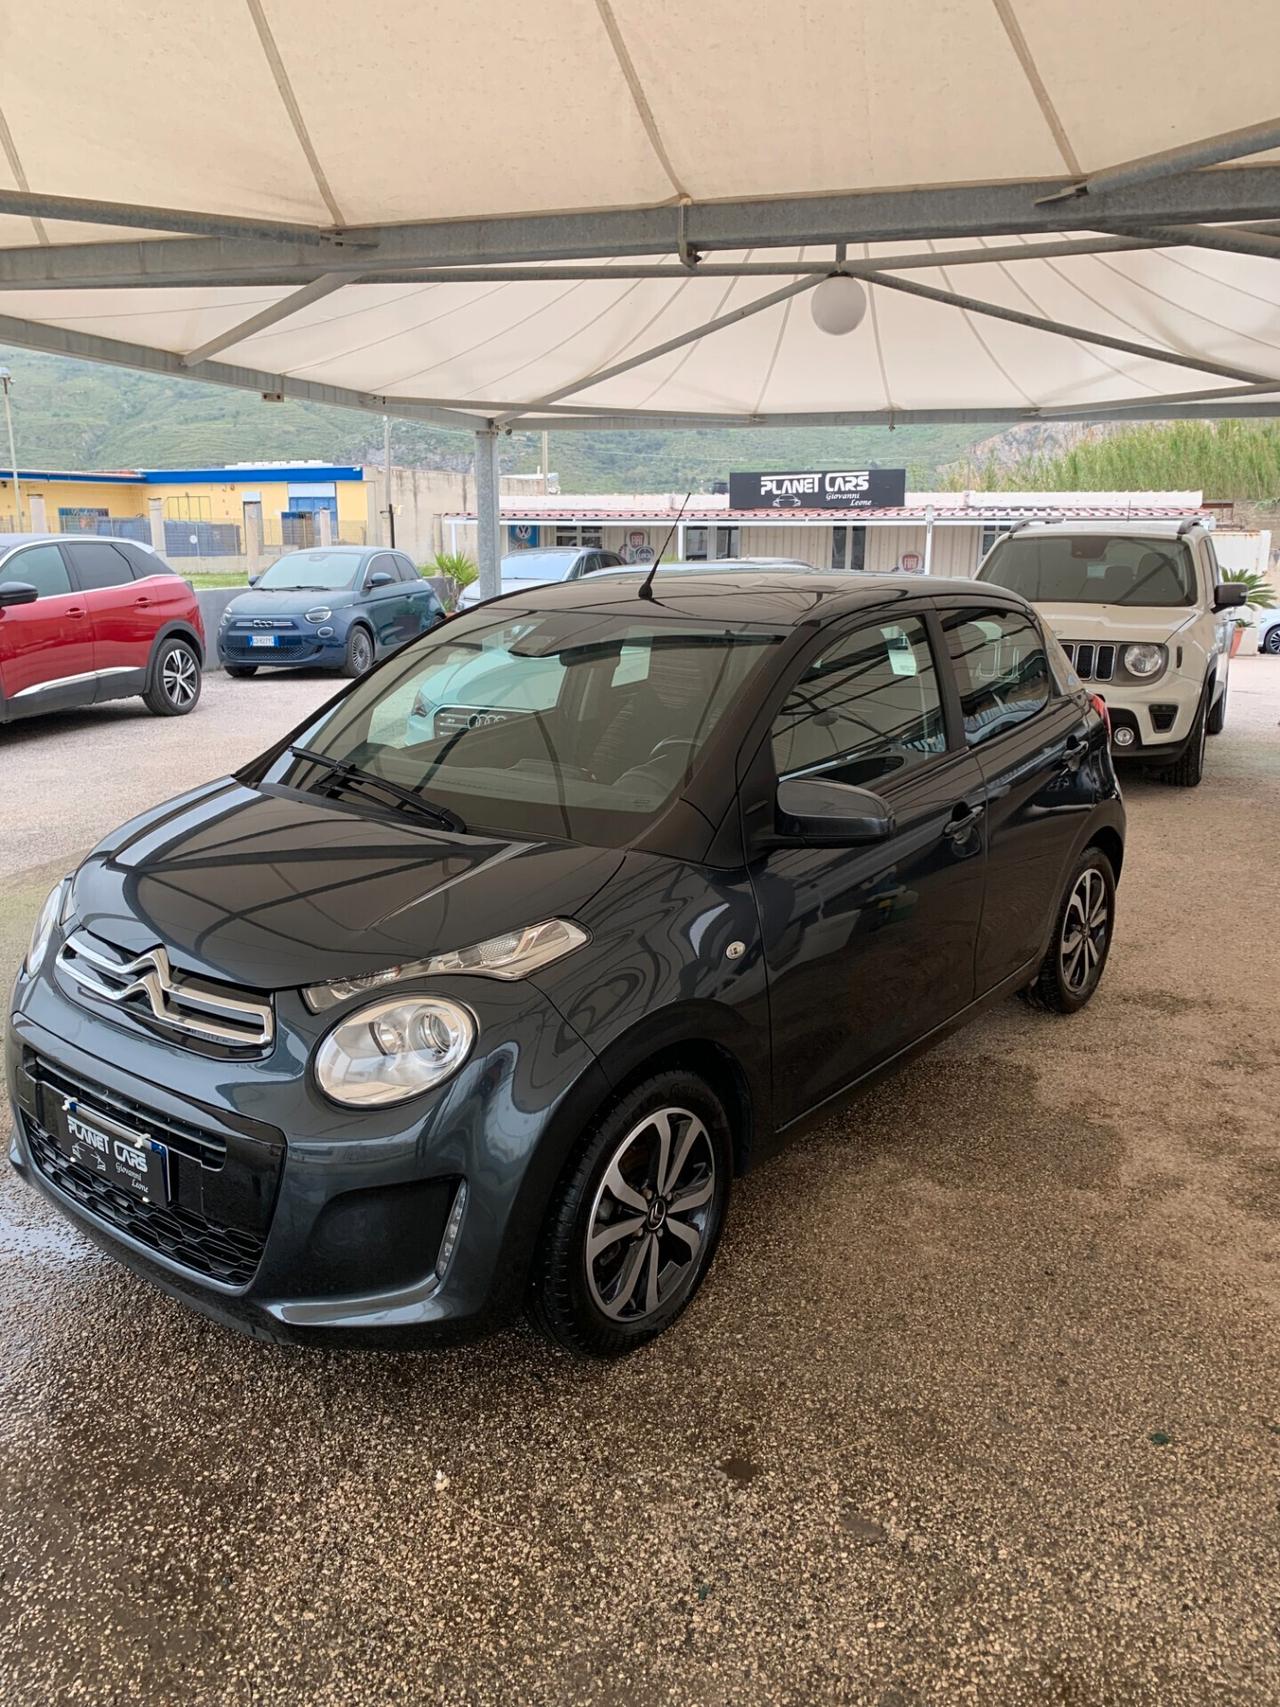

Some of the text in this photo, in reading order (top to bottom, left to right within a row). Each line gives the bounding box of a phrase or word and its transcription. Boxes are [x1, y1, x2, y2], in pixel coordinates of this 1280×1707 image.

[761, 471, 869, 495] PLANET CARS
[825, 492, 860, 501] Giovanni
[850, 498, 872, 507] Leone
[67, 1114, 149, 1173] PLANET CARS
[115, 1162, 142, 1182] Giovanni
[131, 1178, 149, 1194] Leone
